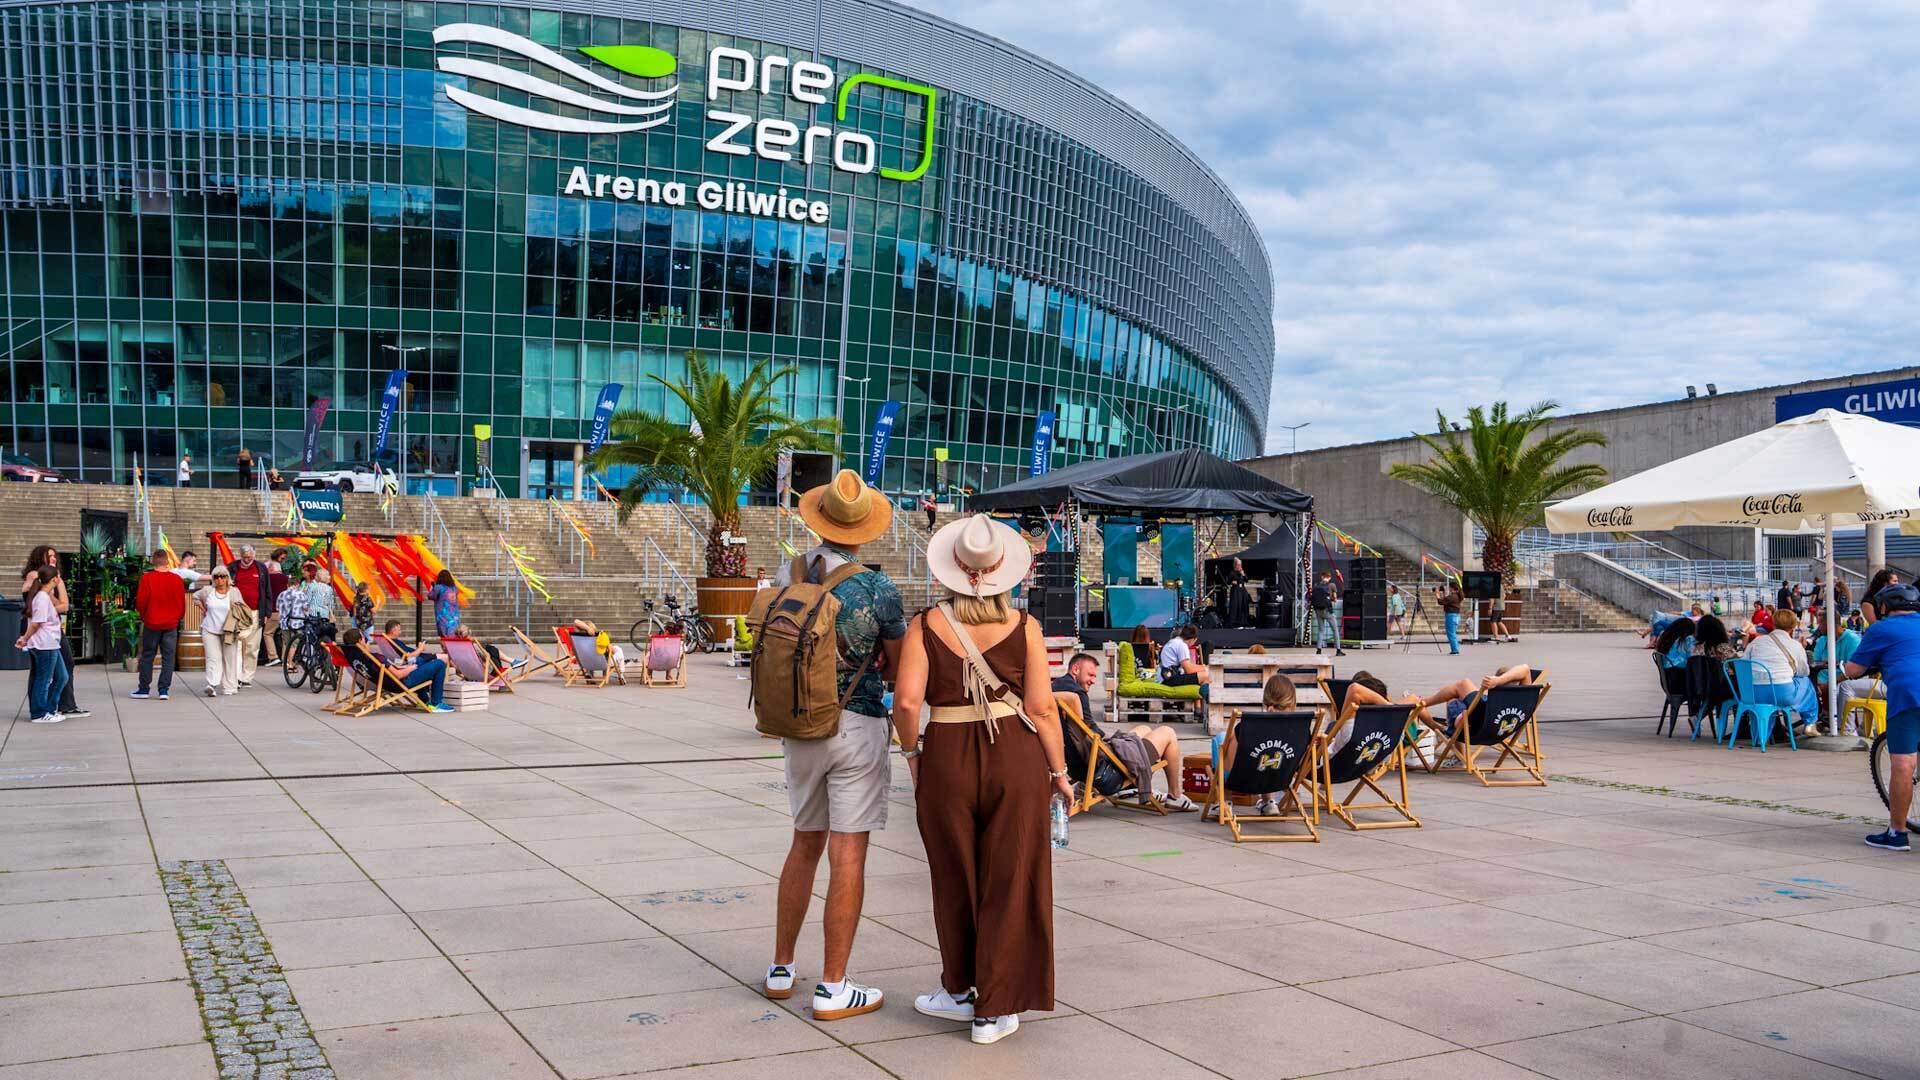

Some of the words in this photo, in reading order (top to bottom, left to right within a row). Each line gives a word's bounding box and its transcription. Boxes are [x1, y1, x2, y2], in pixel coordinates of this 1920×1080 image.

[708, 46, 834, 105] pre
[706, 110, 876, 174] zero
[564, 165, 685, 207] Arena
[697, 180, 830, 224] Gliwice
[1844, 388, 1920, 414] GLIWI
[869, 430, 886, 476] GLIWICE
[1033, 439, 1045, 475] LIWICE
[299, 500, 334, 511] TOALETY
[1587, 505, 1633, 528] Coca-Cola
[1742, 493, 1803, 517] Coca-Cola
[1250, 740, 1295, 759] HARDMADE
